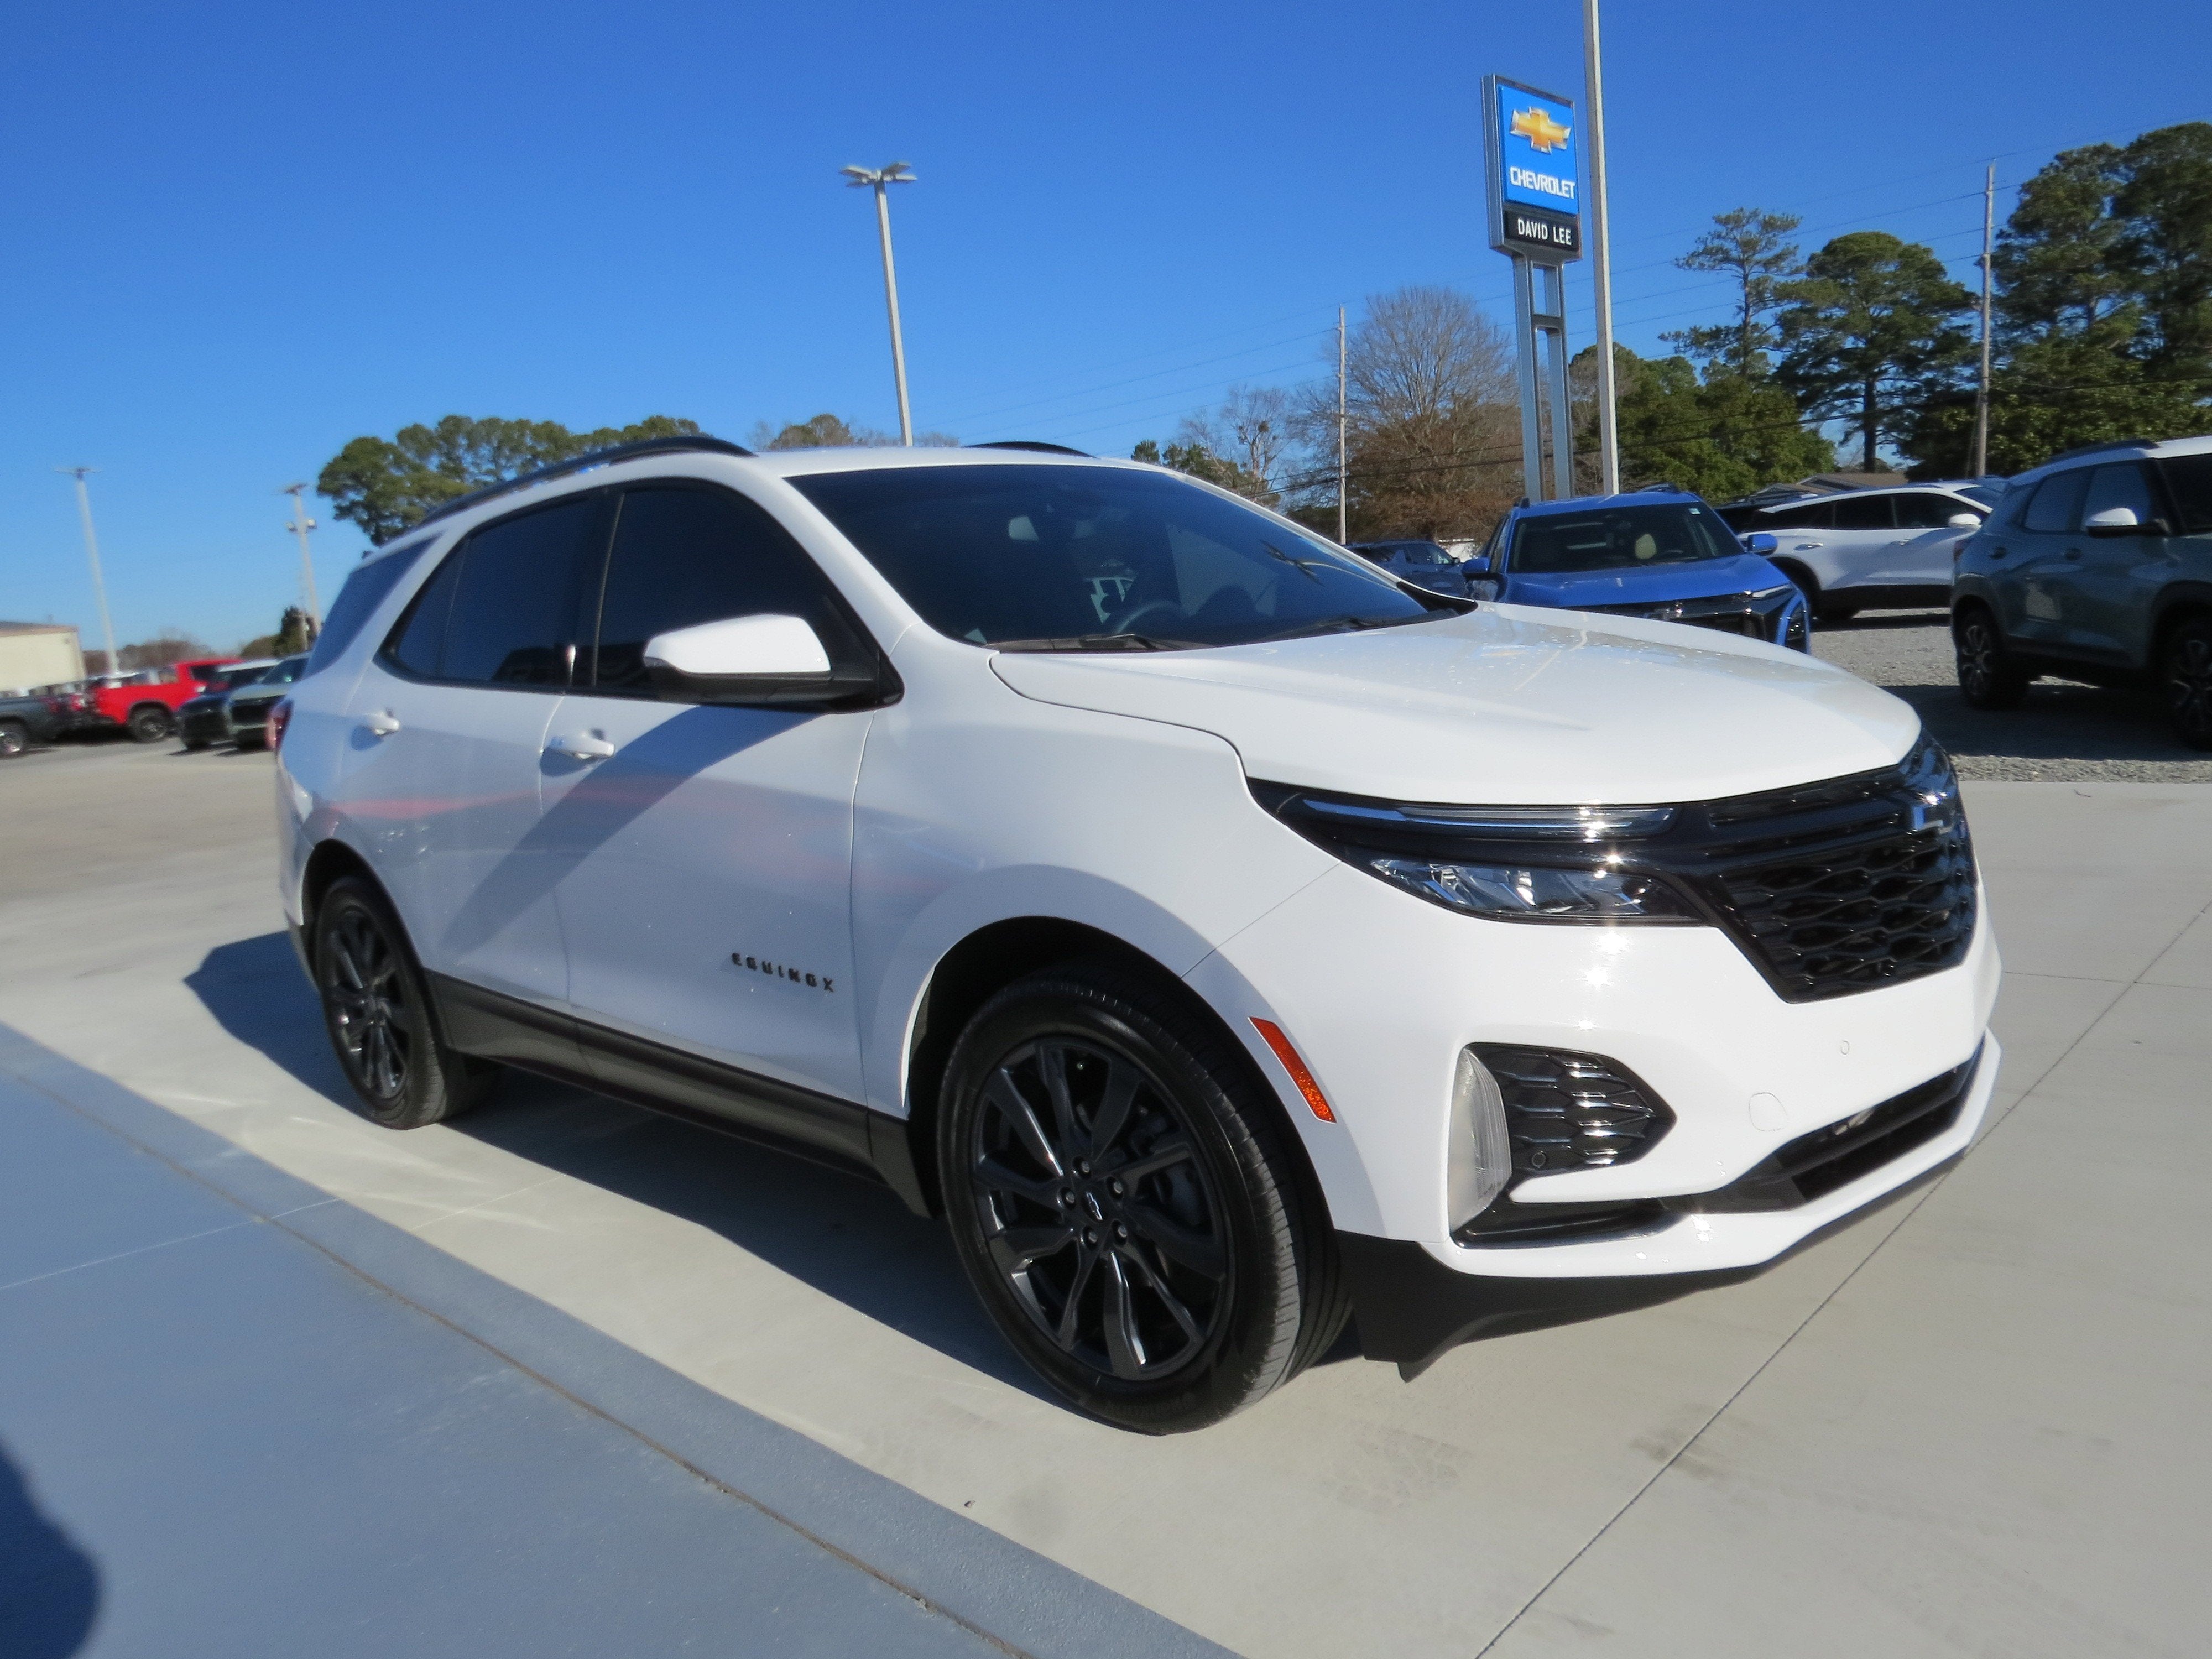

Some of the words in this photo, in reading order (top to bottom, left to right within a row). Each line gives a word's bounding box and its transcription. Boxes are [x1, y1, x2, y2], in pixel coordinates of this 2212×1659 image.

[1510, 166, 1575, 199] CHEVROLET
[1517, 218, 1548, 240] DAVID
[1553, 226, 1572, 246] LEE
[731, 952, 834, 993] EQUINOX
